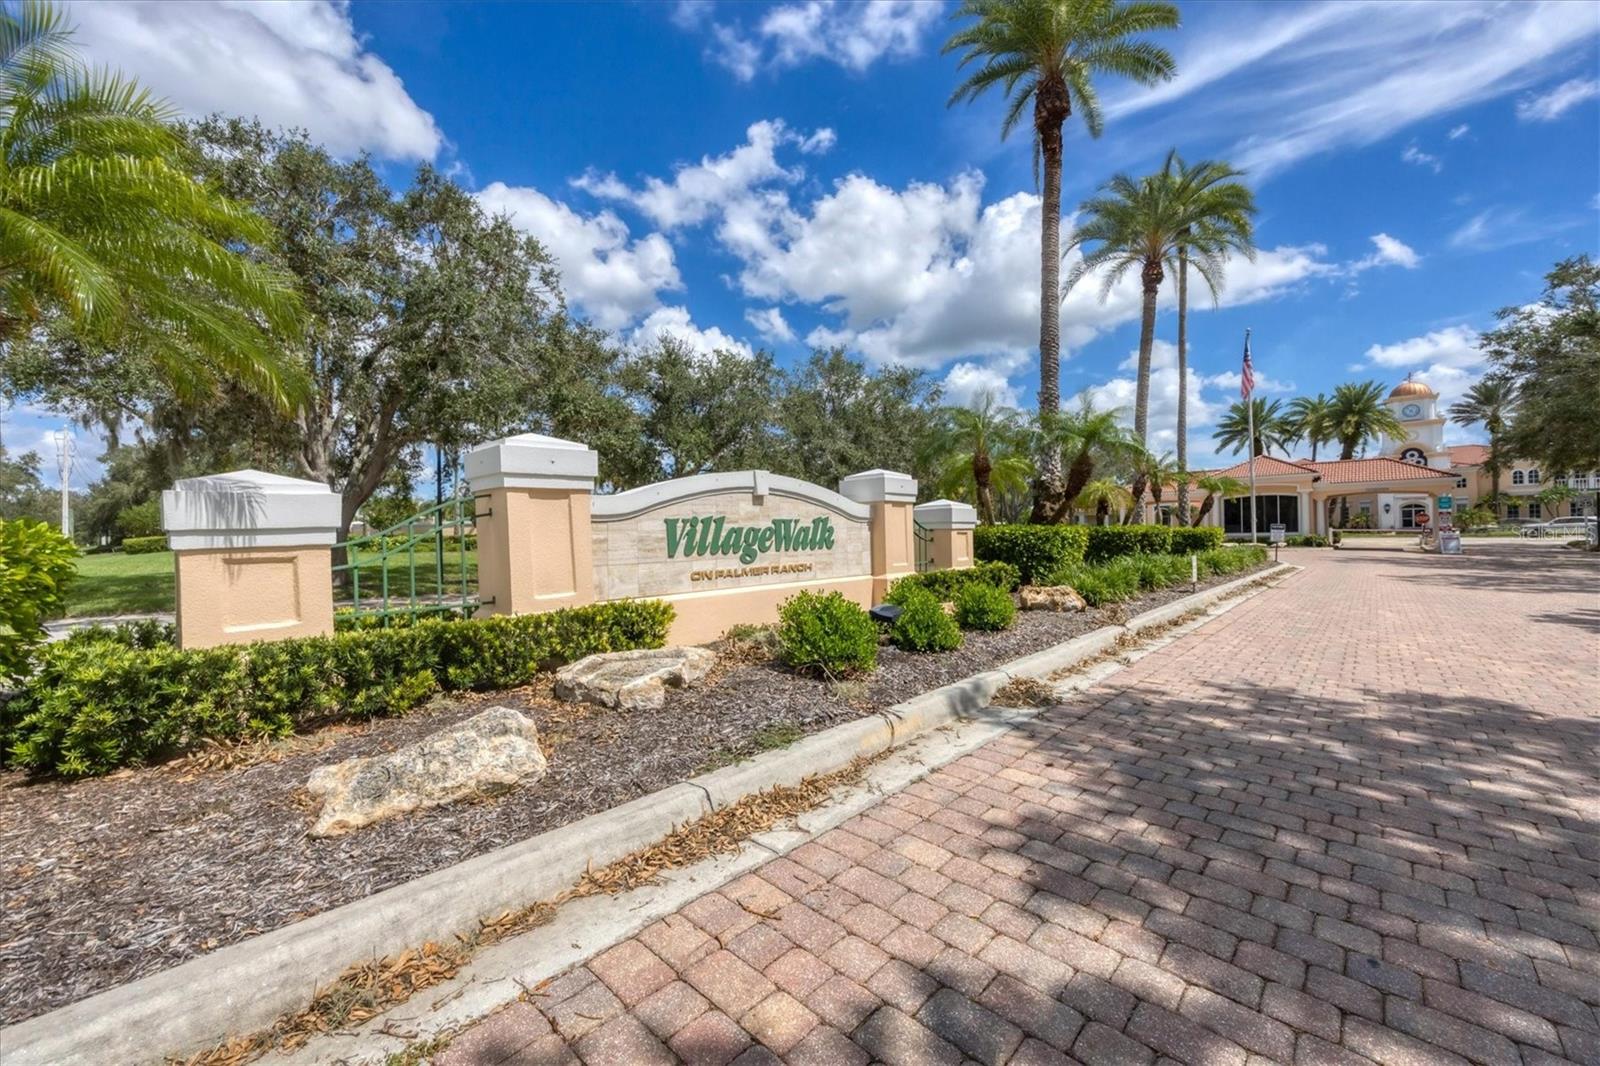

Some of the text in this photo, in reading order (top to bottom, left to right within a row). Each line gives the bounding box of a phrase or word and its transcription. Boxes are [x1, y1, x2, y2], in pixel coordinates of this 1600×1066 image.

[664, 515, 835, 564] VillageWalk
[690, 564, 812, 581] ON PALMER RANCH
